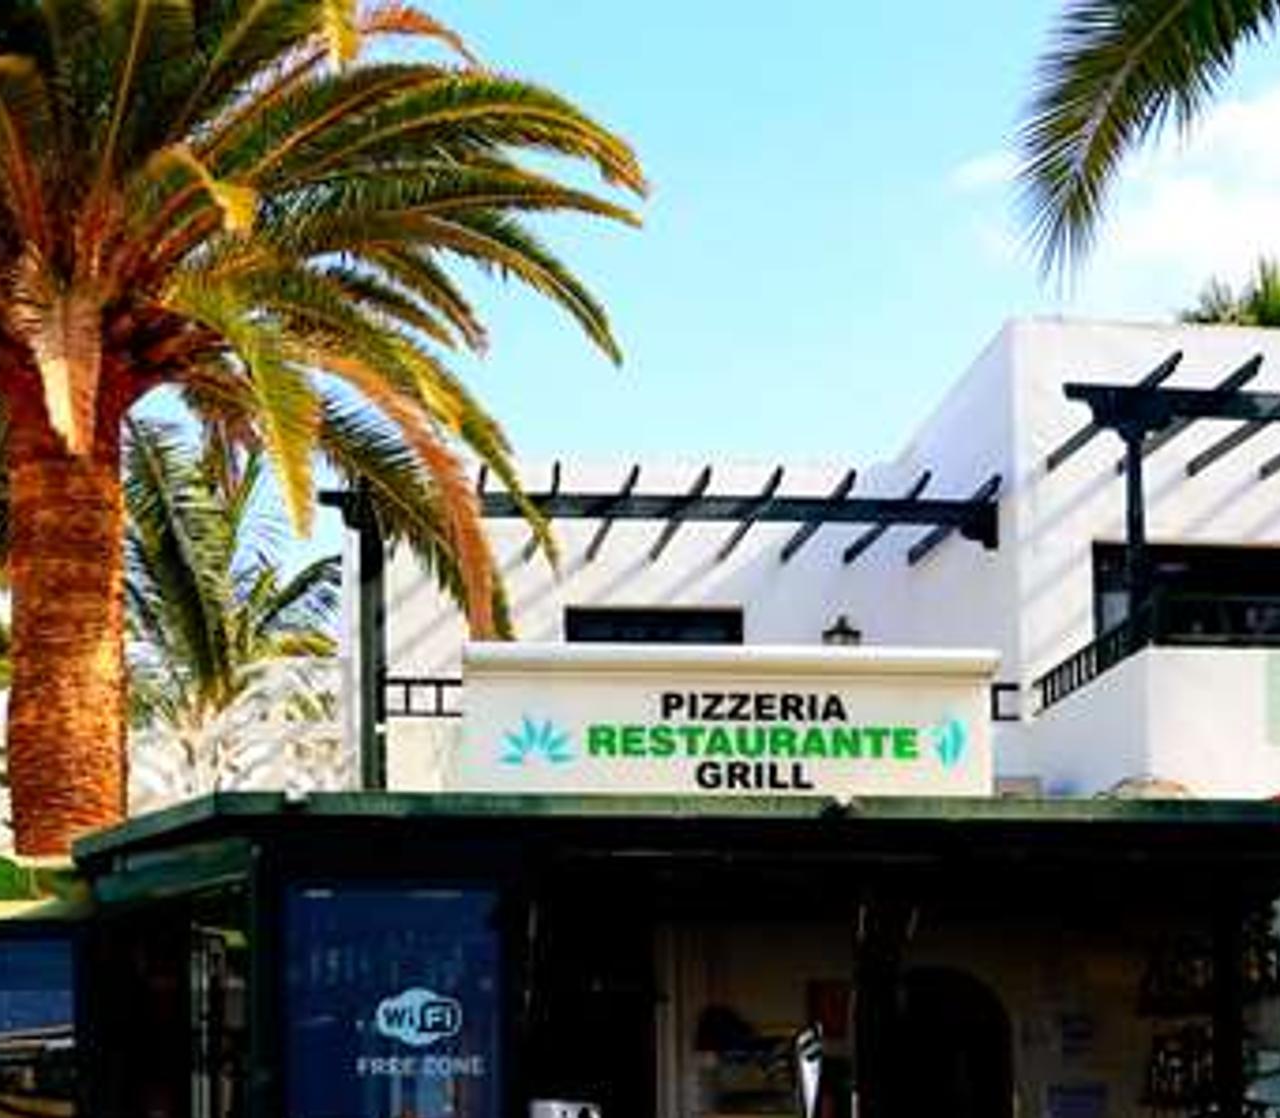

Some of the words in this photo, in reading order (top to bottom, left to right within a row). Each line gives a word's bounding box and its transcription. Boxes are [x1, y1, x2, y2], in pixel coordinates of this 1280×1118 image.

[660, 693, 848, 722] PIZZERIA
[586, 724, 920, 760] RESTAURANTE
[695, 761, 814, 790] GRILL
[356, 1056, 416, 1077] FREE
[422, 1055, 485, 1077] ZONE
